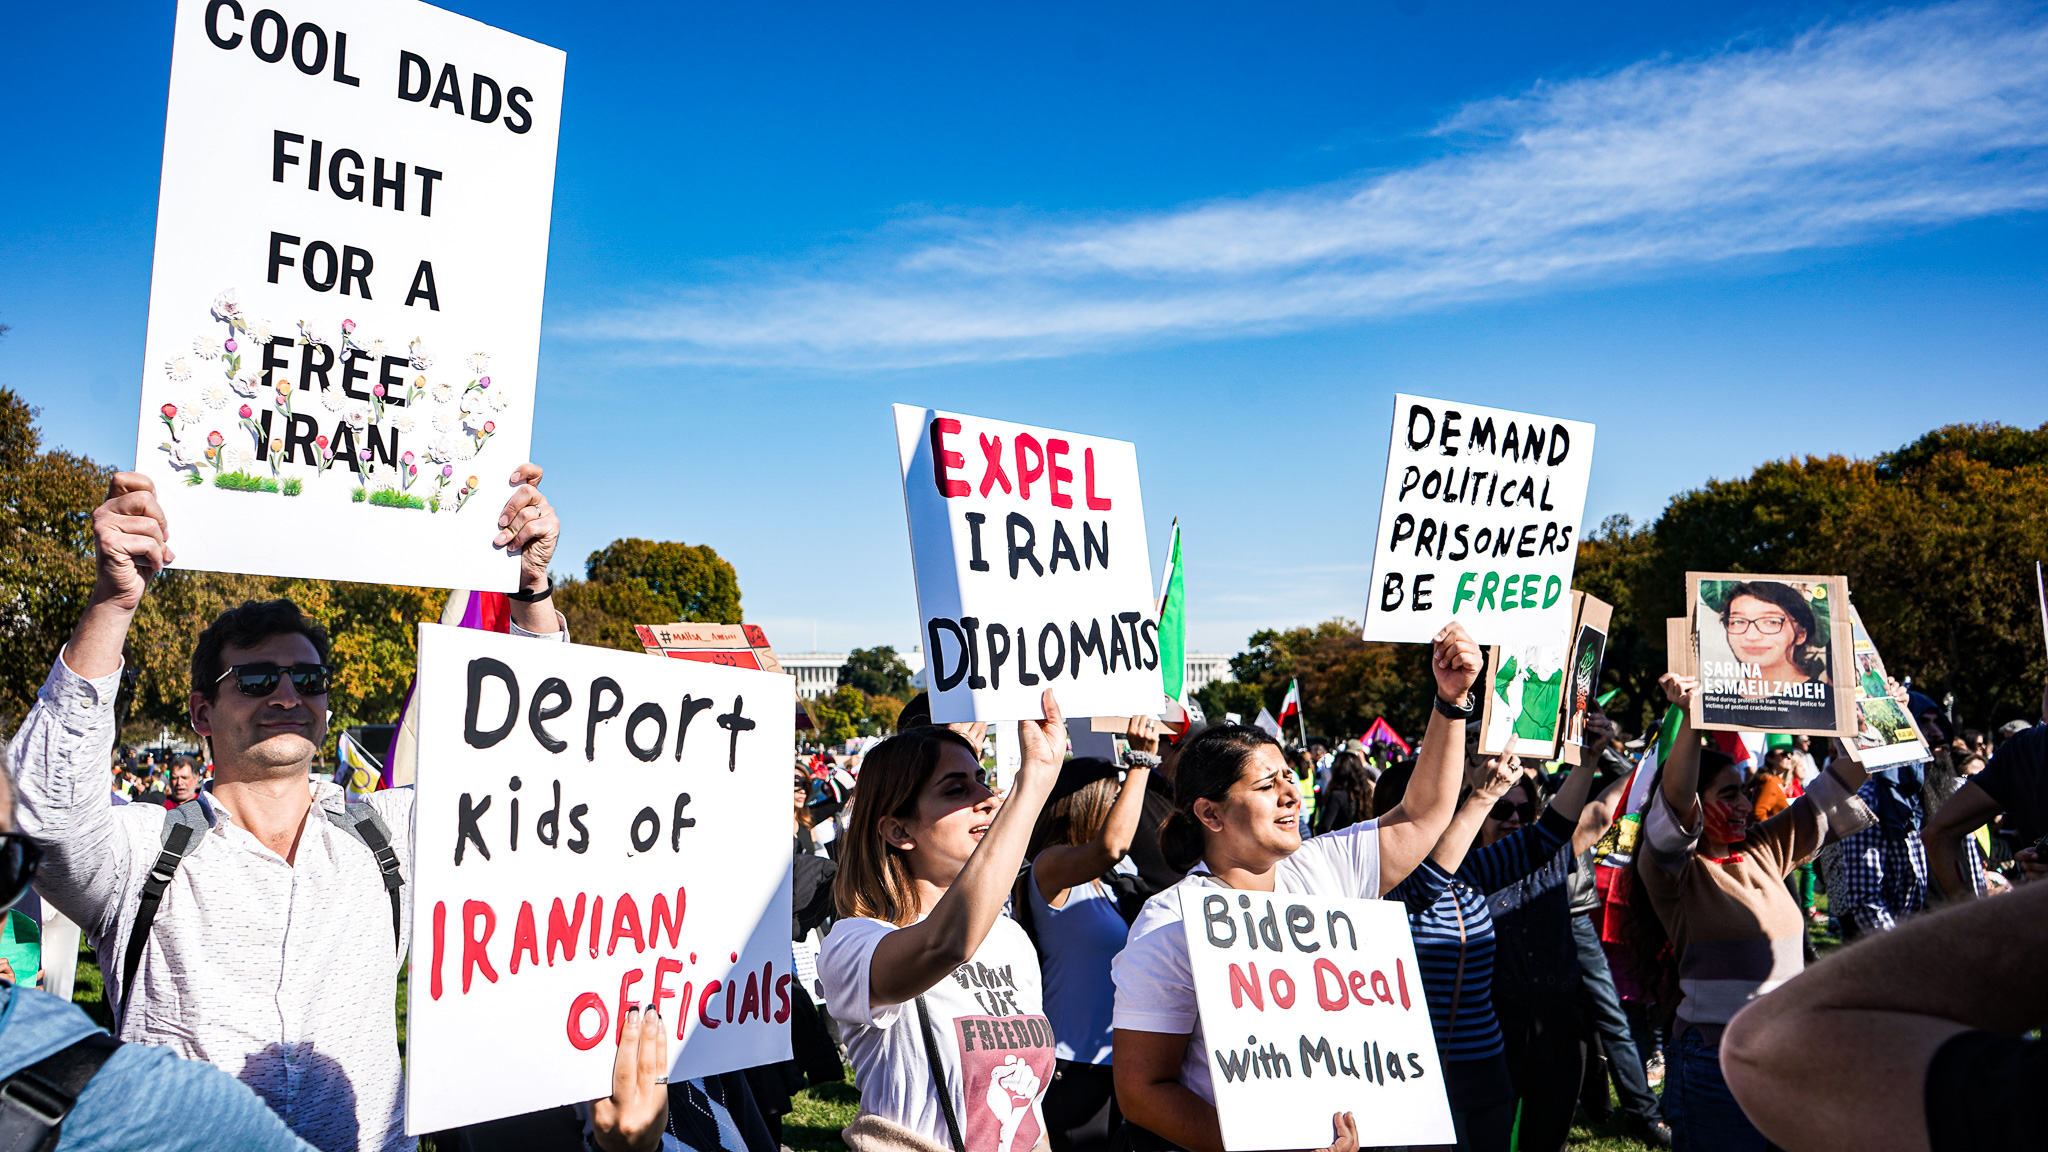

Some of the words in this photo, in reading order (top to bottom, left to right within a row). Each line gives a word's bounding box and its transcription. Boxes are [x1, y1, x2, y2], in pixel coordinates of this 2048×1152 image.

[203, 0, 362, 90] COOL
[396, 48, 534, 136] DADS
[271, 128, 444, 218] FIGHT
[266, 230, 374, 301] FOR
[404, 260, 441, 312] A
[259, 336, 412, 408] FREE
[254, 408, 400, 474] IRAN
[930, 416, 1112, 512] EXPEL
[1406, 404, 1570, 467] DEMAND
[1398, 465, 1555, 512] POLITICAL
[964, 510, 1110, 580] IRAN
[1390, 512, 1573, 562] PRISONERS
[1380, 571, 1436, 612] BE
[1452, 571, 1563, 615] FREED
[927, 611, 1159, 693] DIPLOMATS
[1703, 661, 1762, 679] SARINA
[1704, 678, 1825, 699] ESMAEILZADEH
[430, 886, 687, 1001] IRANIAN
[1203, 894, 1358, 953] Biden
[1228, 961, 1296, 1012] No
[1313, 957, 1411, 1012] Deal
[1215, 1034, 1292, 1084] with
[1299, 1034, 1425, 1086] Mullas
